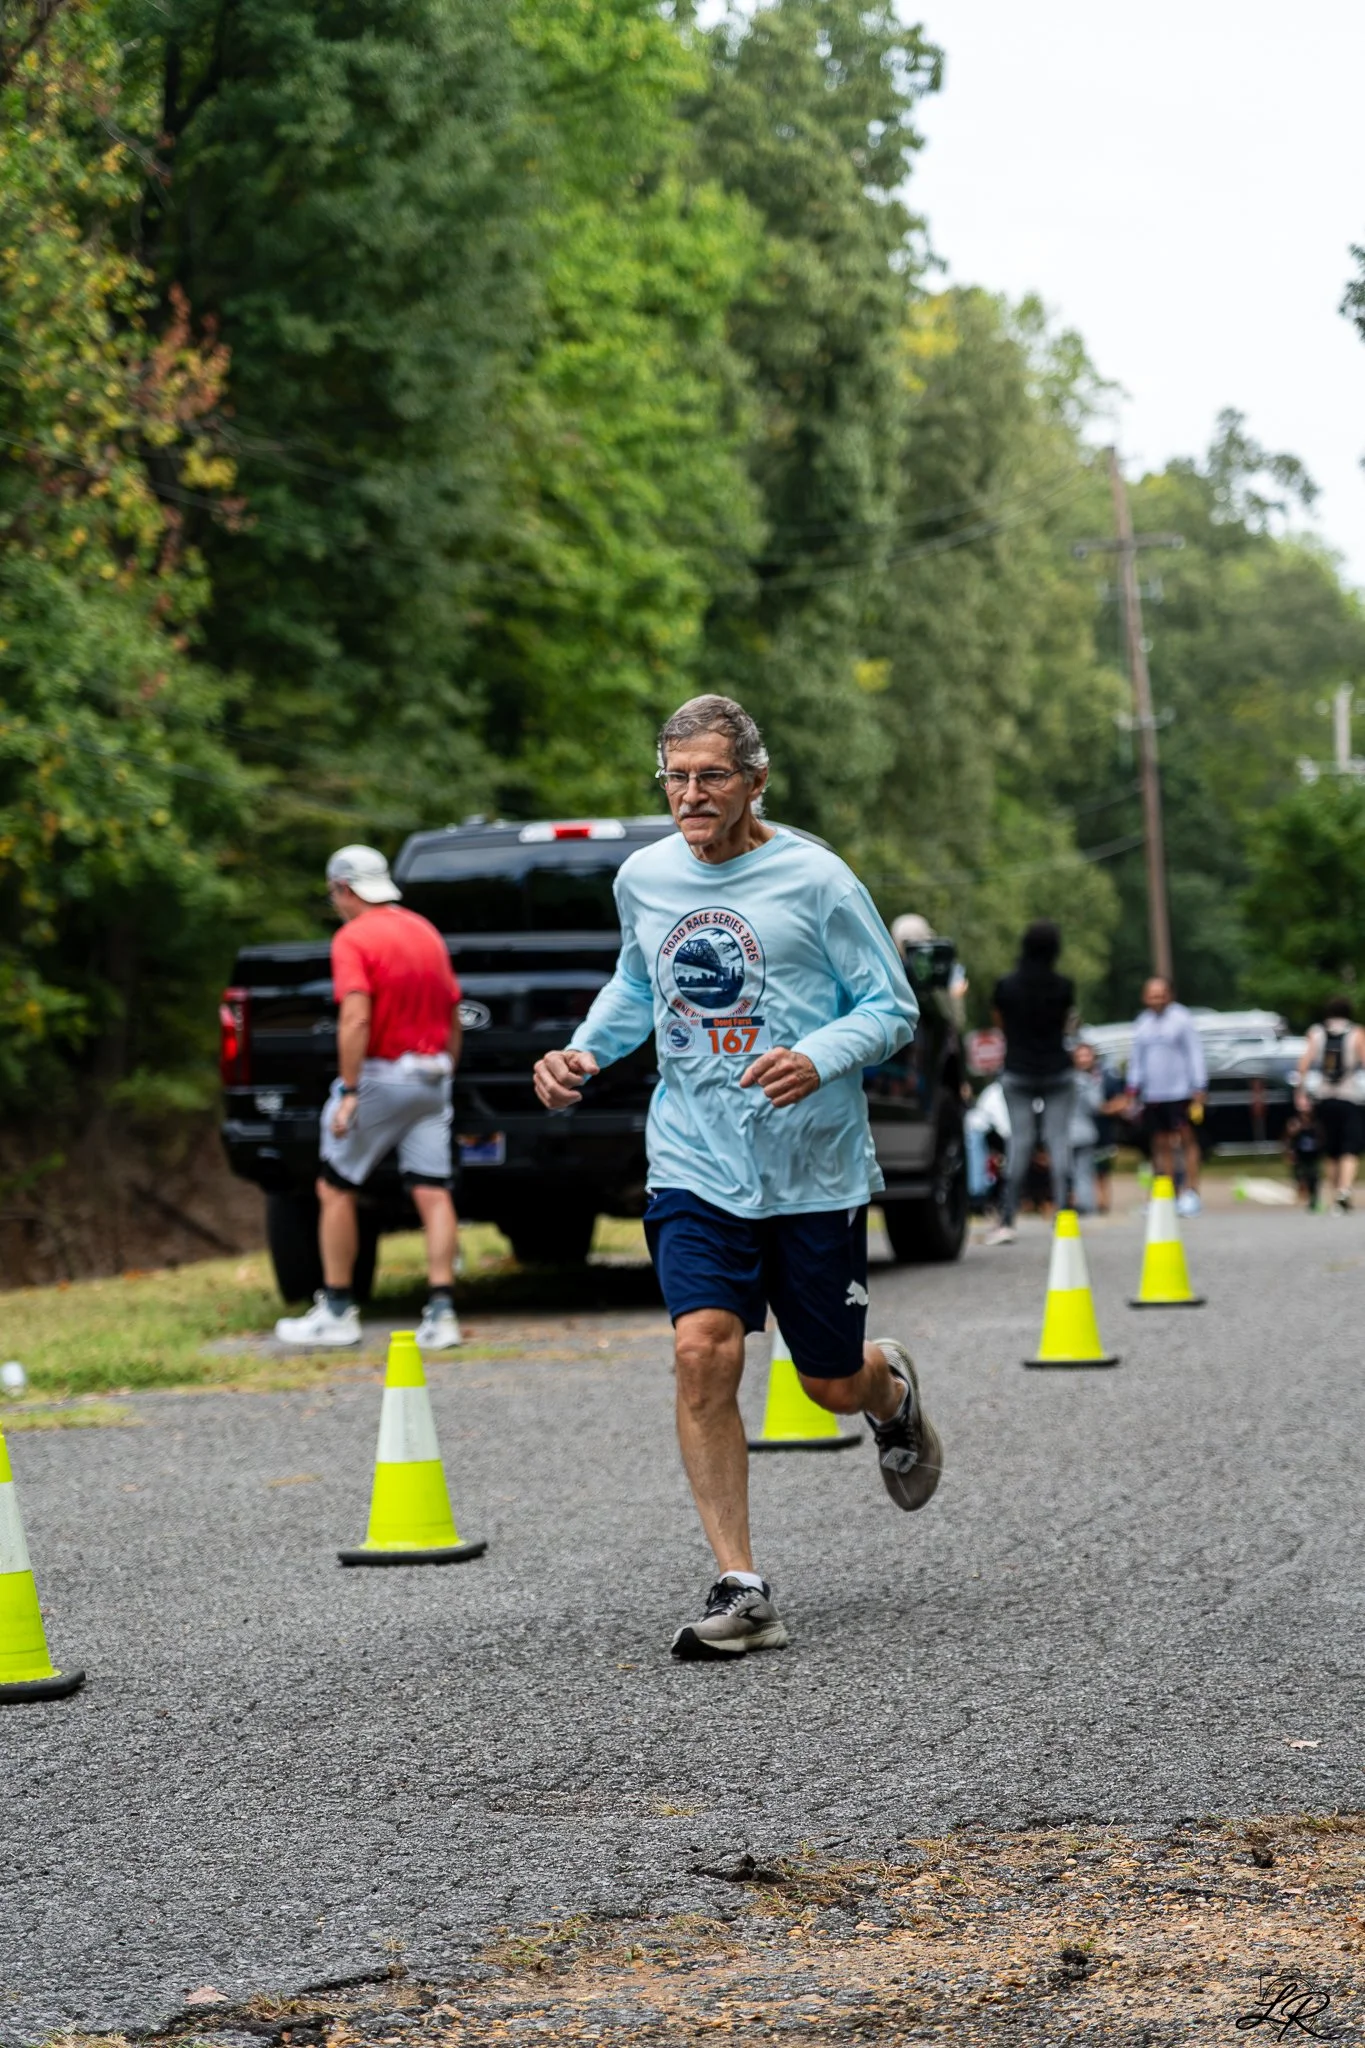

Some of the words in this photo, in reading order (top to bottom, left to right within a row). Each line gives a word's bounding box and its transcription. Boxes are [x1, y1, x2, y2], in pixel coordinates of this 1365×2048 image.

[663, 928, 686, 957] ROAD
[685, 912, 711, 932] RACE
[712, 911, 744, 934] SERIES
[740, 932, 759, 962] 2026
[708, 1028, 760, 1055] 167
